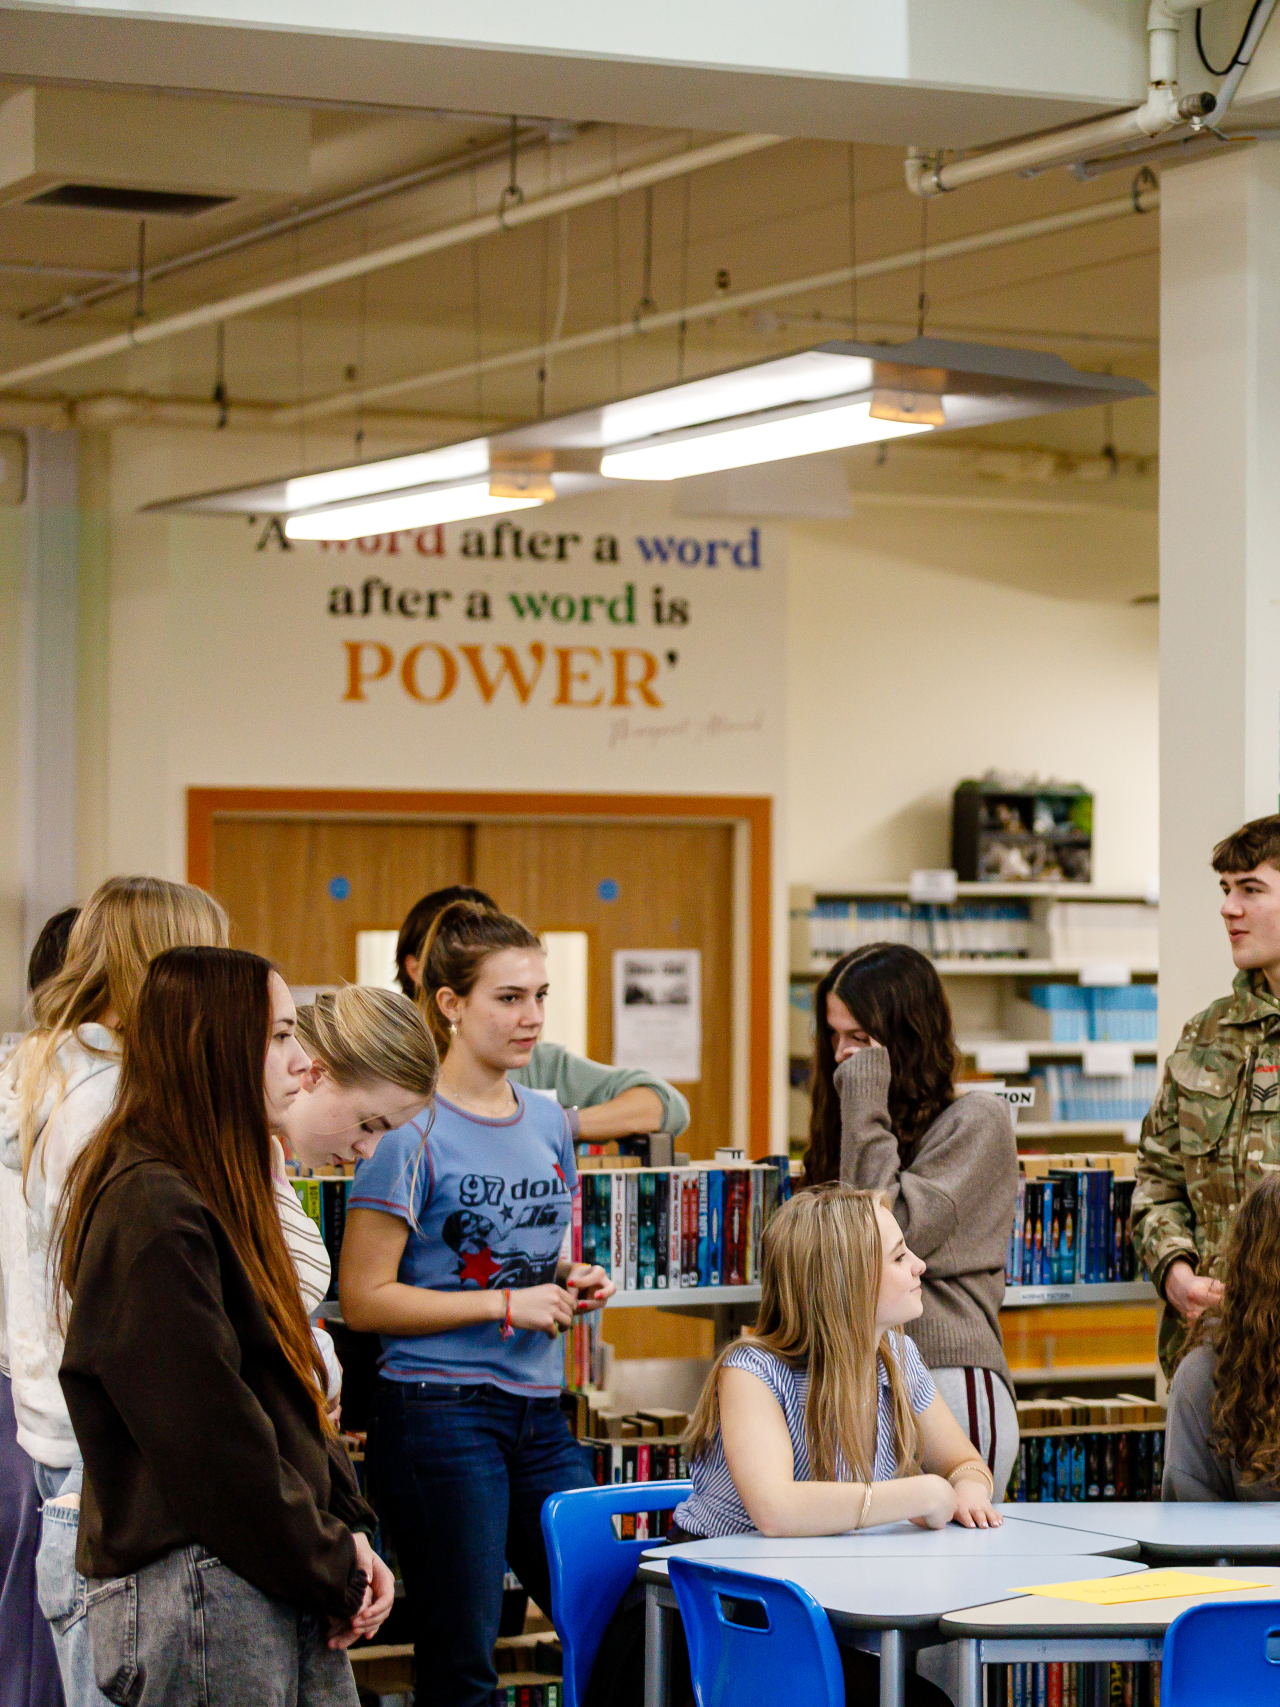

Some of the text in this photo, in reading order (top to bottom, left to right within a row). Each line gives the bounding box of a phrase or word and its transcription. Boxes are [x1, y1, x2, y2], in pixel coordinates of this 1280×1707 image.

[315, 524, 446, 557] ord
[460, 522, 581, 563] after
[593, 532, 620, 564] a
[636, 529, 762, 569] word
[327, 579, 690, 627] after a word is
[460, 1173, 505, 1206] 97
